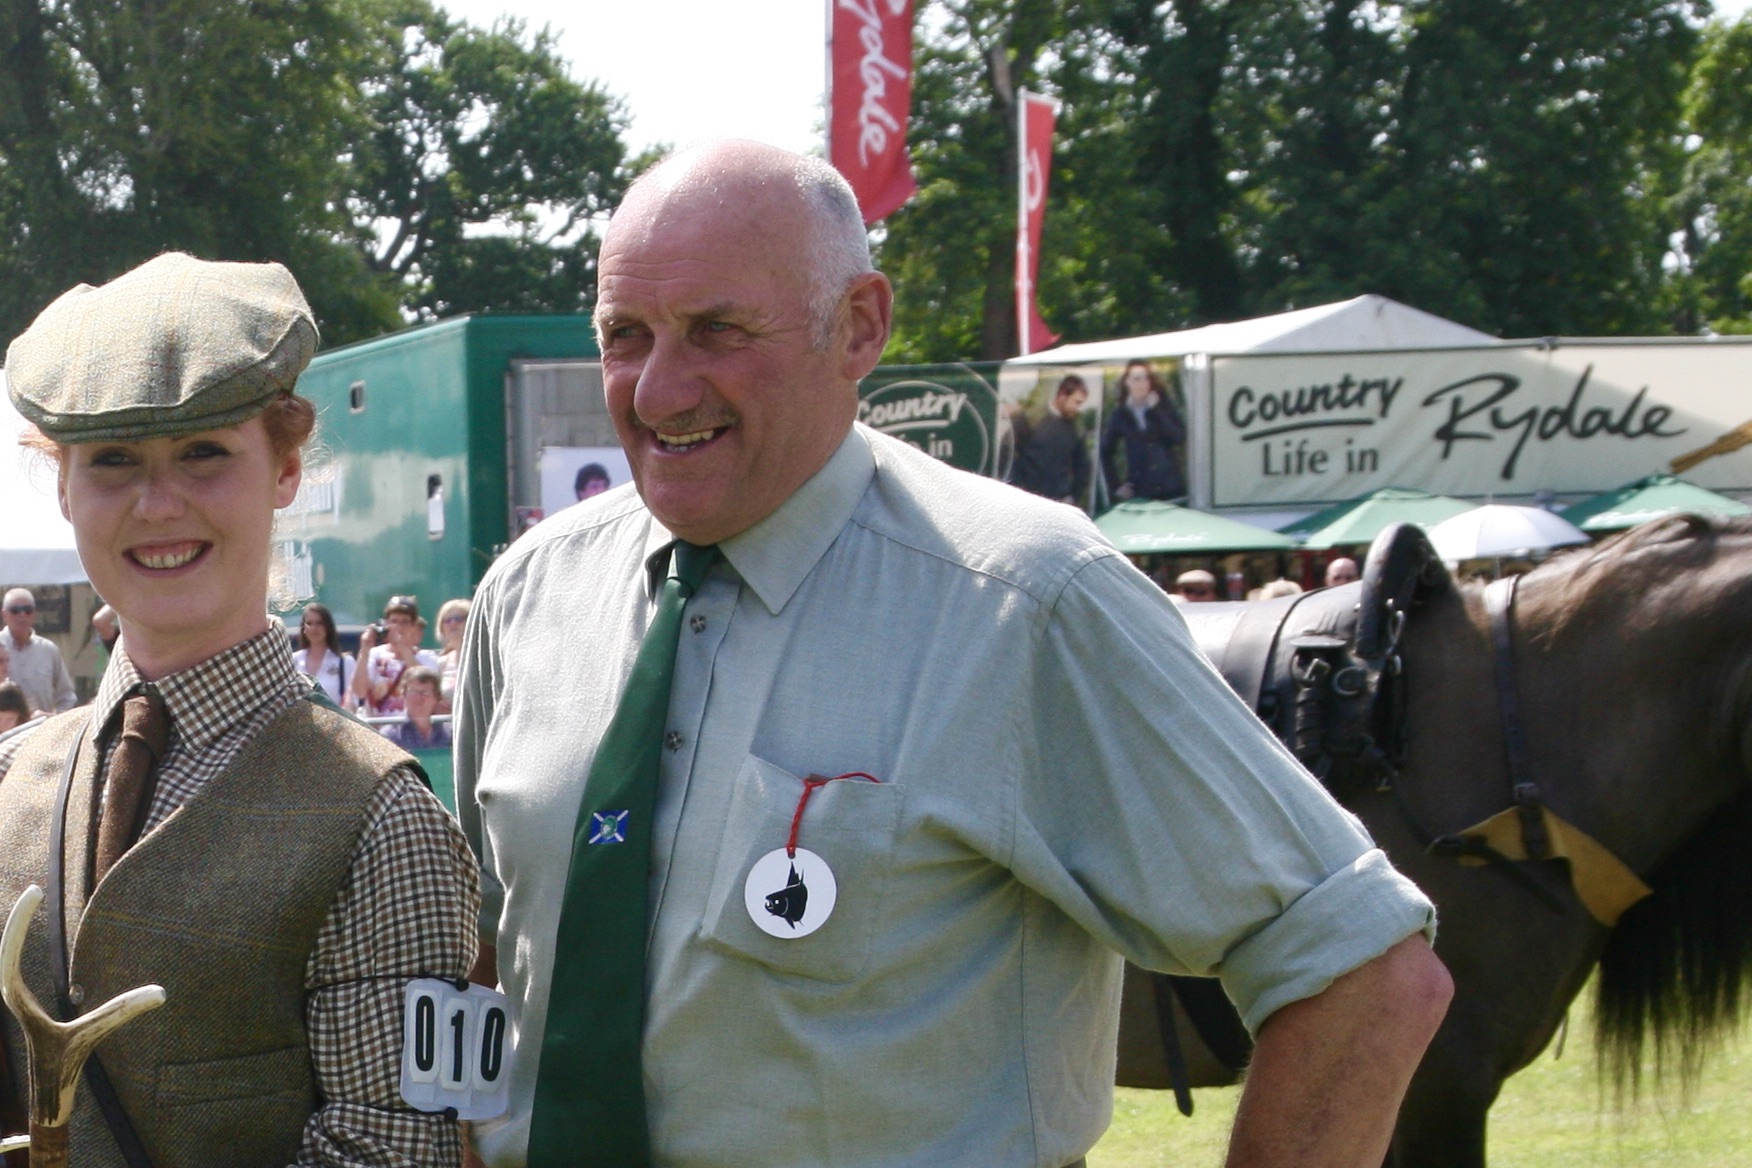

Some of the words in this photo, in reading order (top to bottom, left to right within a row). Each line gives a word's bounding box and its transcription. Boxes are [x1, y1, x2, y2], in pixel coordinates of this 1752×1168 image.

[837, 0, 908, 169] ydale
[1228, 374, 1403, 429] Country
[1421, 363, 1690, 481] Rydale
[1262, 441, 1333, 477] Life
[1346, 439, 1379, 473] in
[416, 995, 506, 1083] 010
